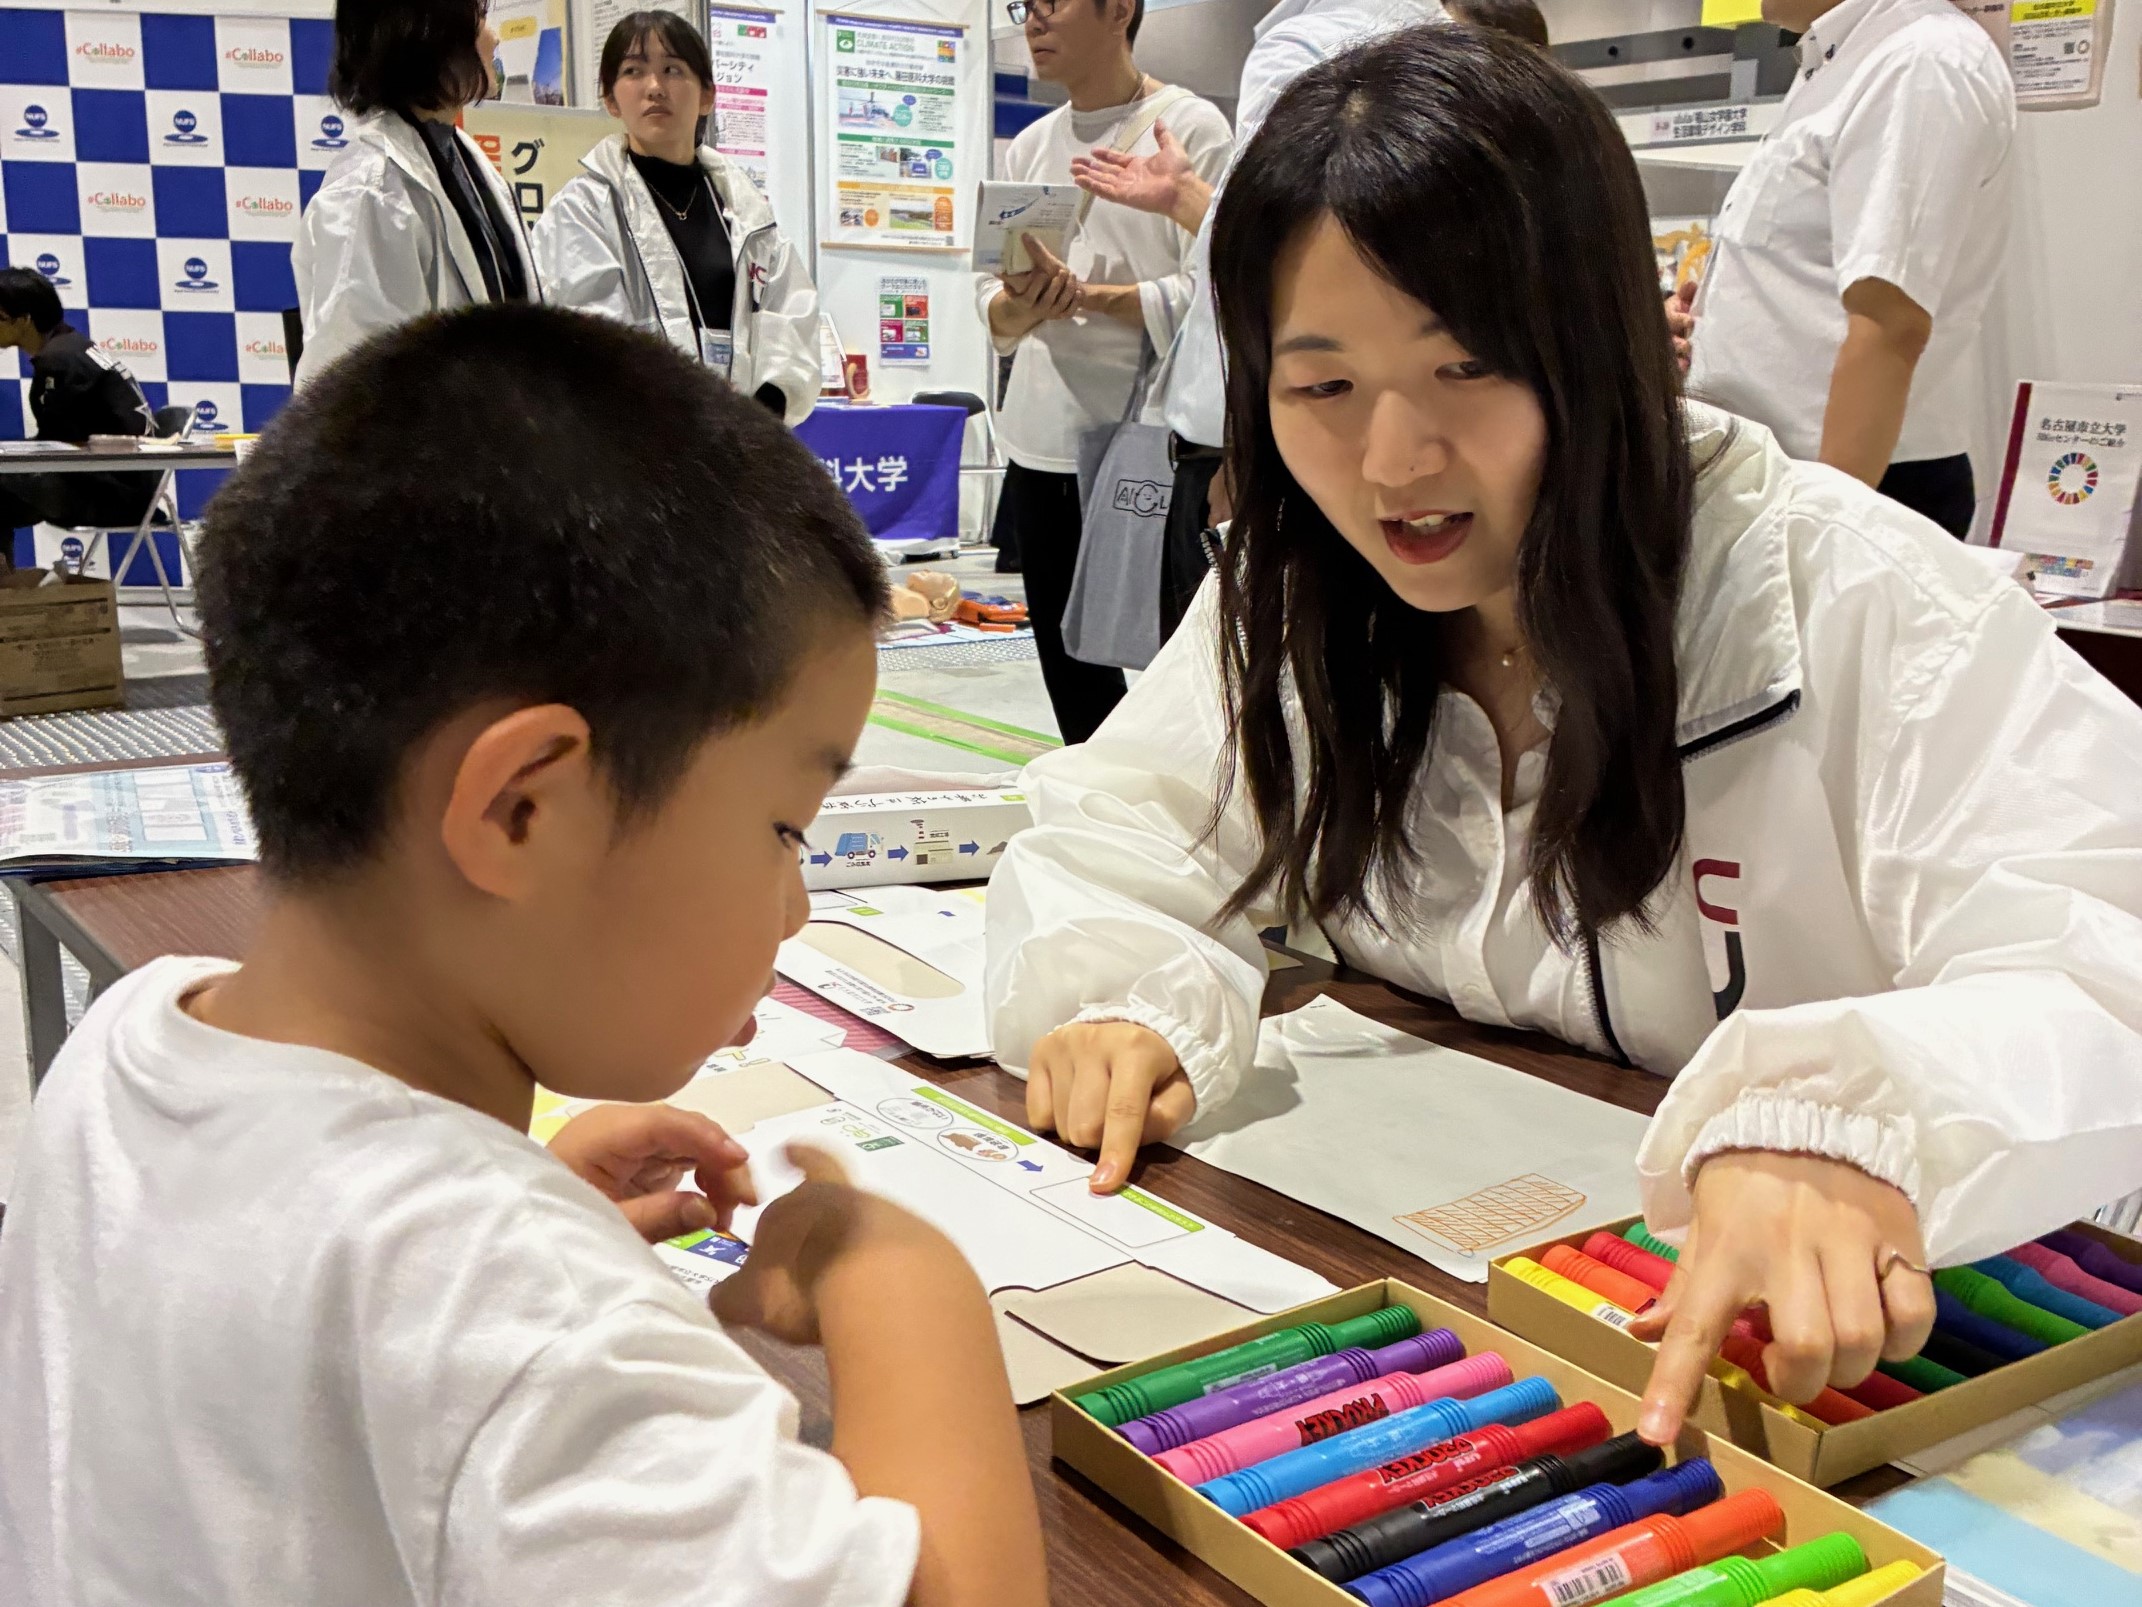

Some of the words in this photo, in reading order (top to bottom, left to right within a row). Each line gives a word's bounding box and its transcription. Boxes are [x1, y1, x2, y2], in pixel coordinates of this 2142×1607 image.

[2041, 417, 2126, 436] 名古屋市立大学
